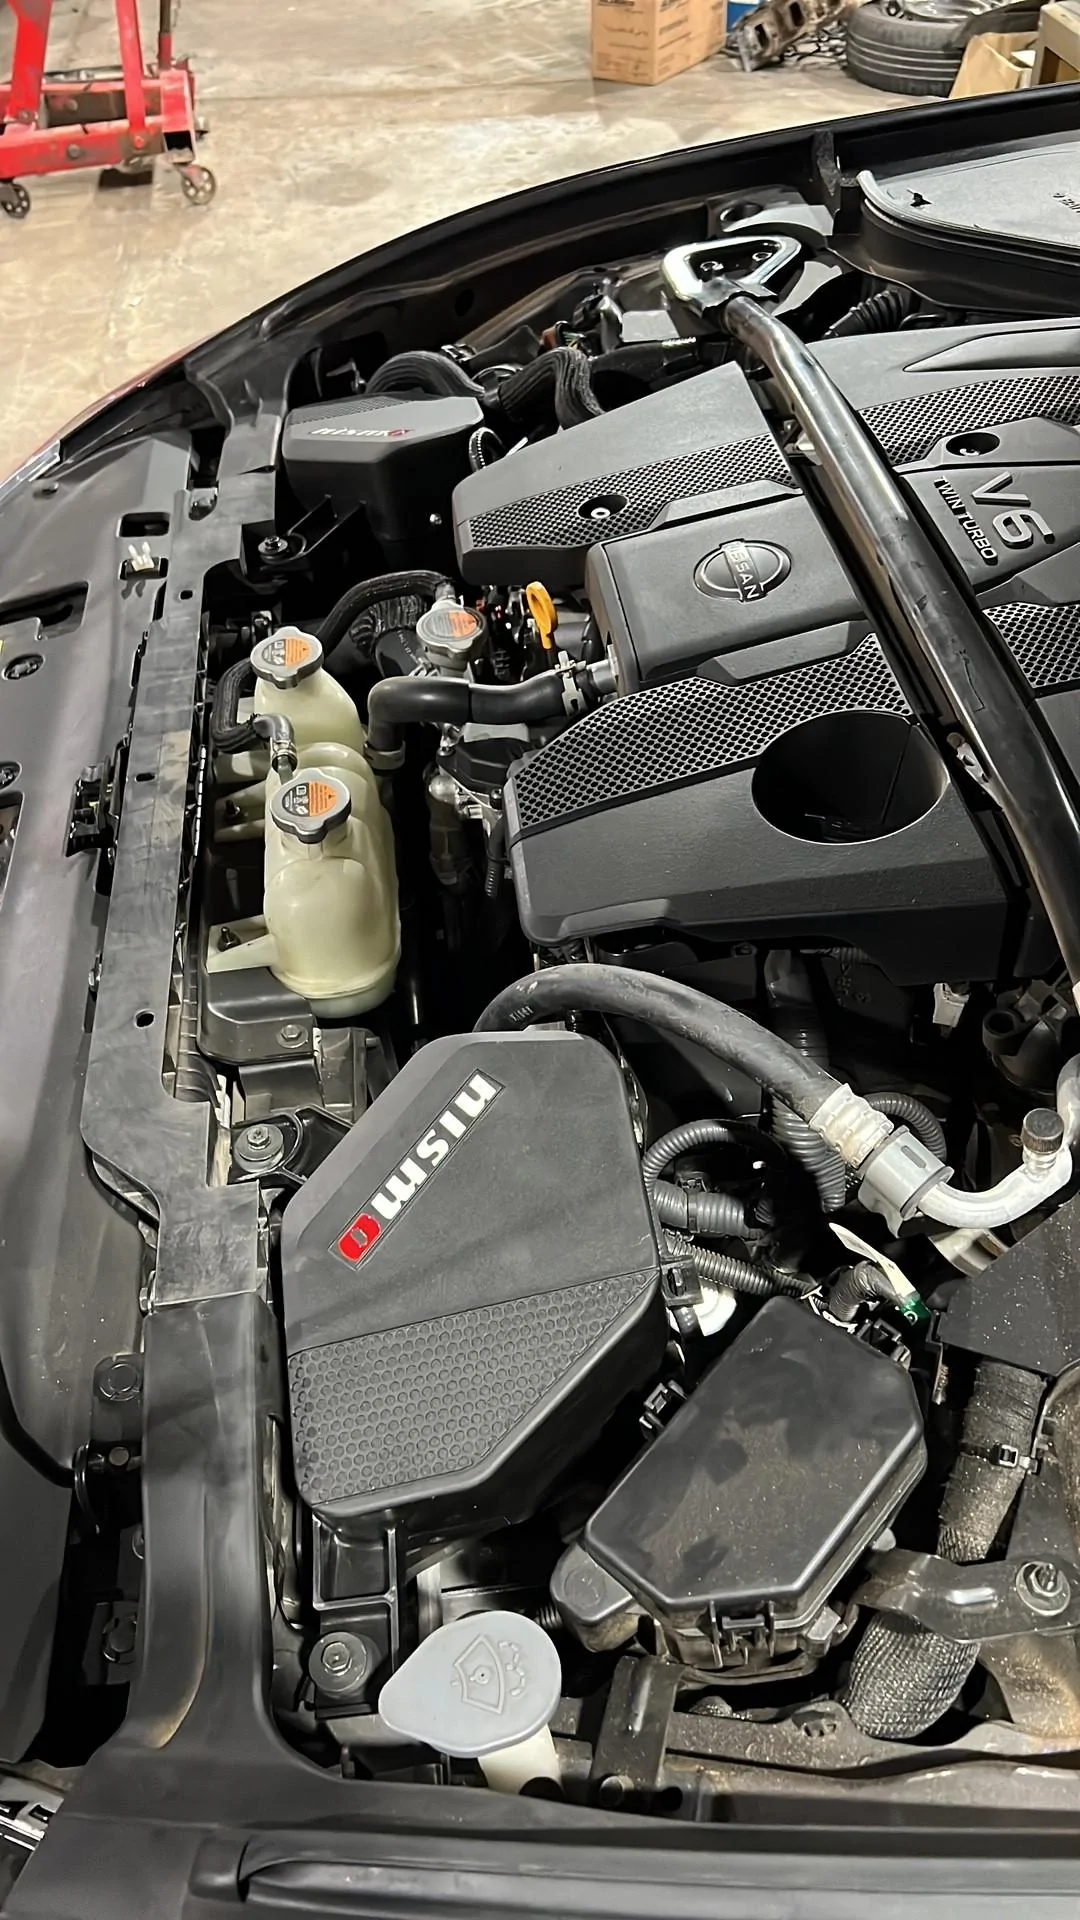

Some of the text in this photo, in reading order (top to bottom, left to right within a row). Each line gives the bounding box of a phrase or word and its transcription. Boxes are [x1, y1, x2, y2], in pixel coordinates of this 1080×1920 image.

[934, 475, 998, 562] TWIN TURBO
[971, 471, 1054, 547] V6
